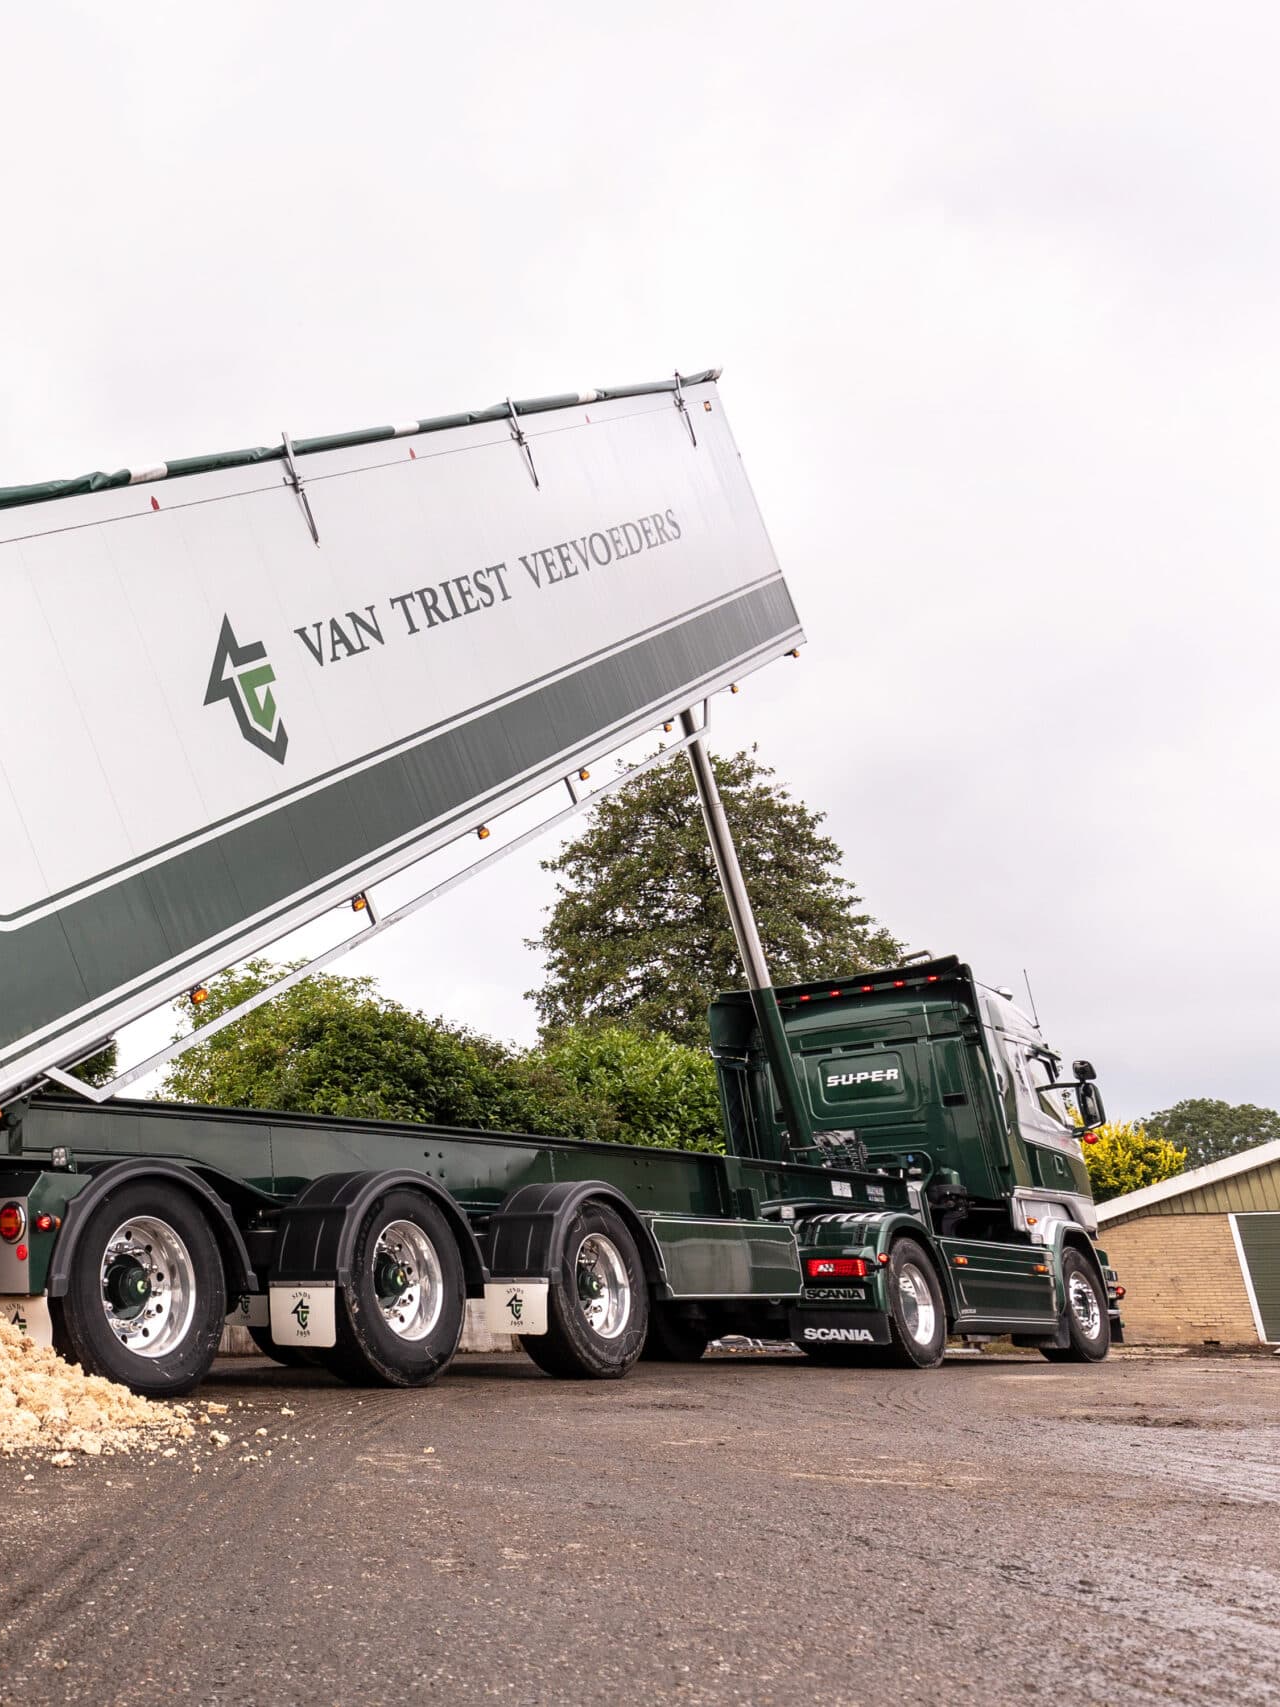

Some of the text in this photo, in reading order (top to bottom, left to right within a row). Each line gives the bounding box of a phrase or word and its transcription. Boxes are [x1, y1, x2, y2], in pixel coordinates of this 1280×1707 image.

[293, 507, 682, 667] VAN TRIEST VEEVOEDERS
[826, 1068, 899, 1087] SUPER
[806, 1288, 863, 1300] SCANIA
[803, 1327, 875, 1342] SCANIA
